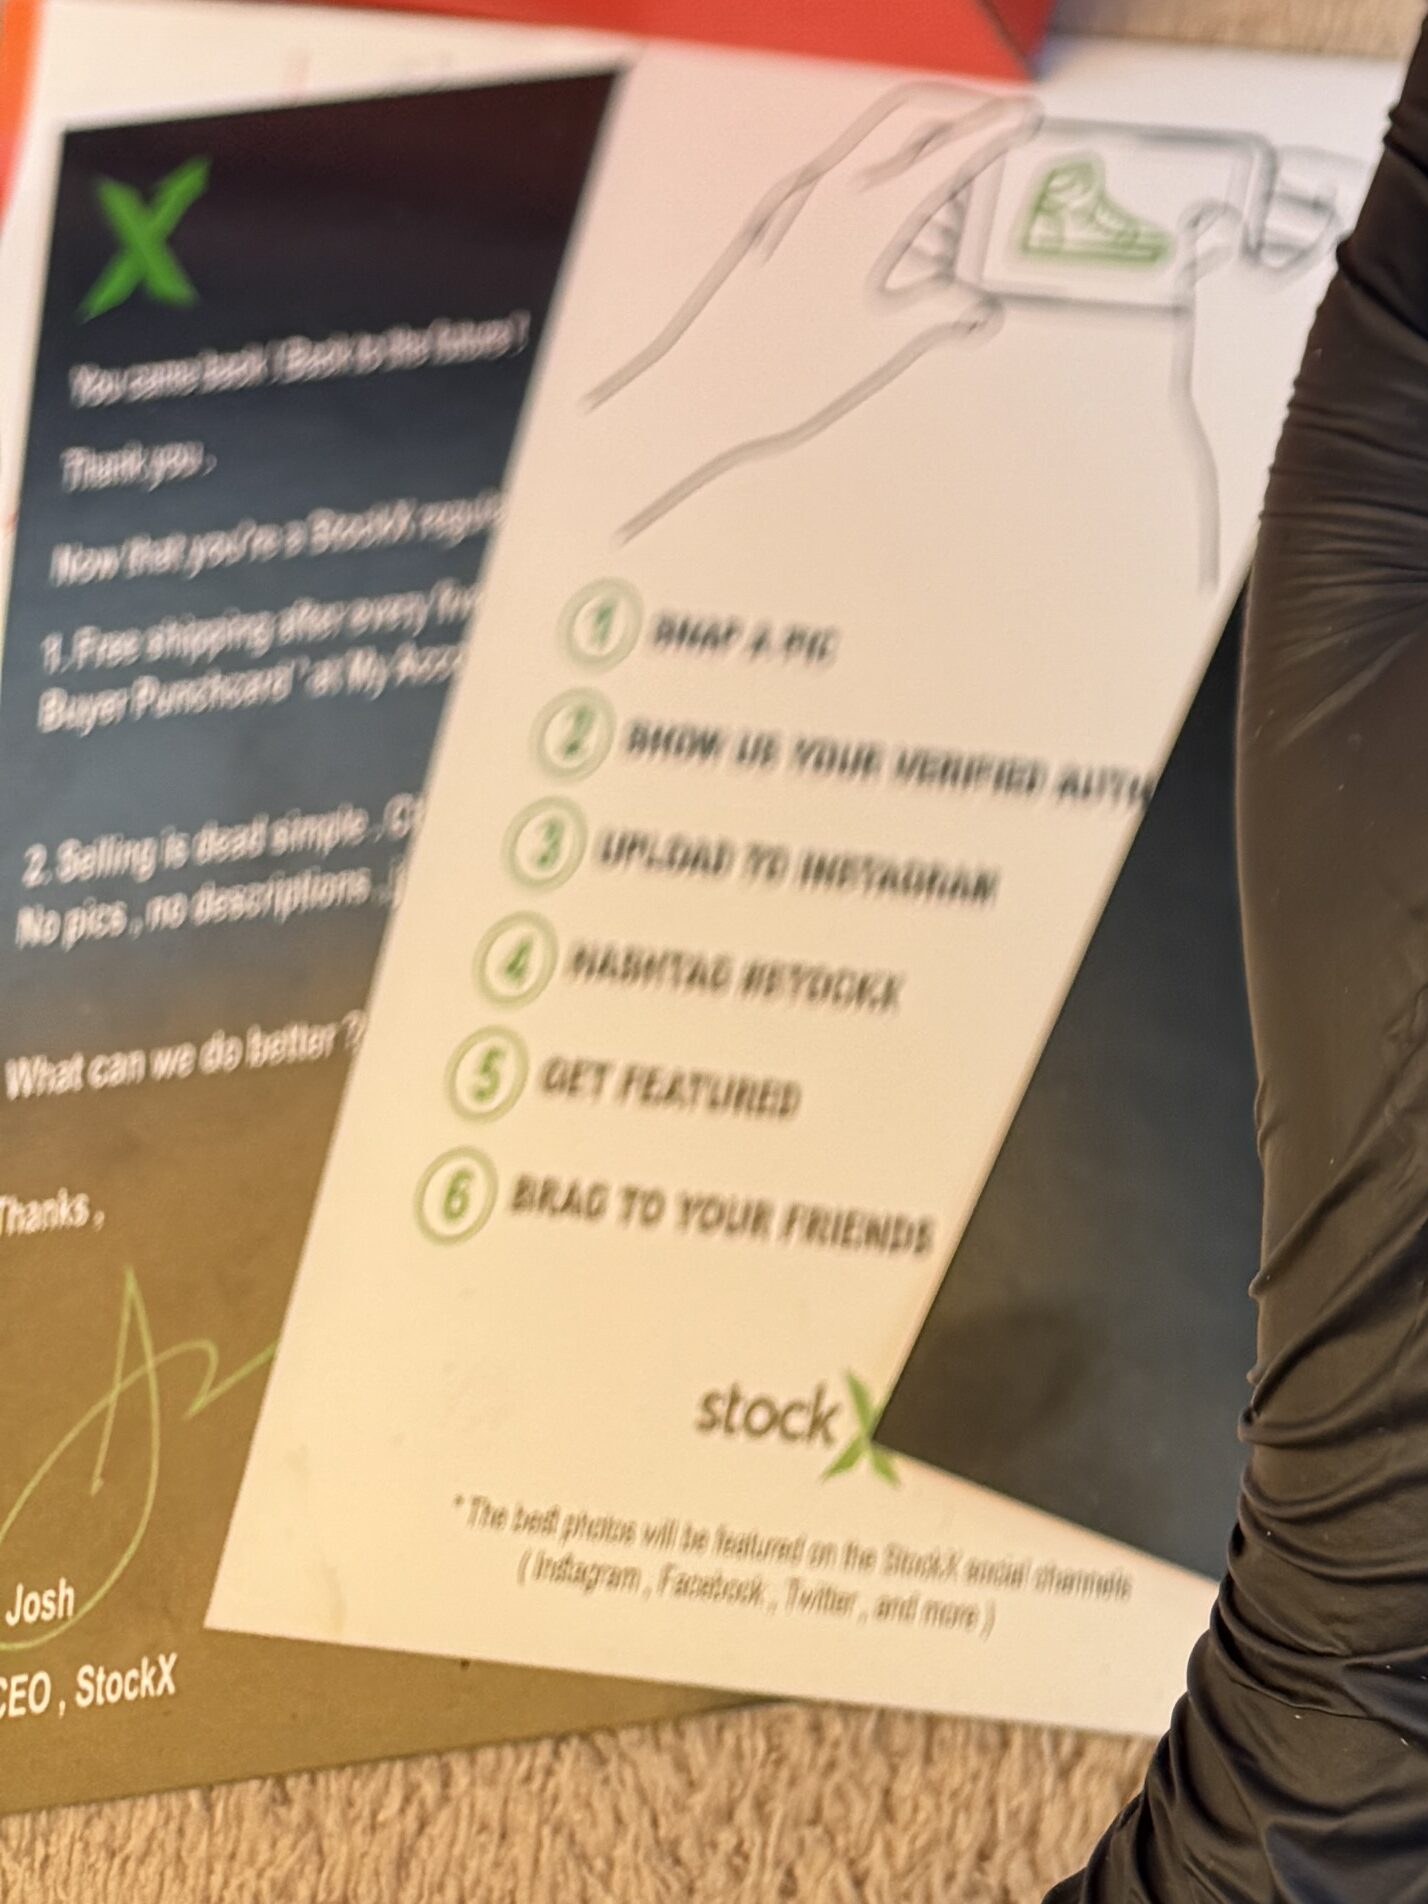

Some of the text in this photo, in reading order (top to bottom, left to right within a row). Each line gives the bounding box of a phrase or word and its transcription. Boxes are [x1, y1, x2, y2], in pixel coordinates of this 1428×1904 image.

[51, 542, 119, 587] Now
[120, 532, 187, 578] that
[72, 624, 142, 670] Free
[143, 607, 274, 665] shipping
[275, 596, 346, 647] after
[346, 589, 428, 638] every
[37, 687, 130, 738] Buyer
[345, 644, 389, 702] My
[796, 733, 881, 781] YOUR
[895, 743, 1051, 803] VERIFIED
[55, 830, 157, 884] Selling
[160, 823, 191, 870] is
[191, 812, 269, 866] dead
[598, 826, 729, 879] UPLOAD
[743, 841, 790, 884] TO
[799, 845, 1001, 907] INSTAGRAM
[15, 902, 61, 949] No
[145, 892, 188, 932] no
[565, 940, 731, 994] HASHTAG
[4, 1051, 84, 1101] What
[86, 1048, 146, 1090] can
[150, 1041, 197, 1082] we
[200, 1028, 243, 1075] do
[539, 1055, 613, 1102] GET
[617, 1065, 803, 1121] FEATURED
[509, 1172, 605, 1224] BRAG
[616, 1186, 665, 1228] TO
[675, 1191, 773, 1242] YOUR
[777, 1198, 936, 1256] FRIENDS
[466, 1493, 508, 1530] The
[511, 1500, 560, 1538] best
[558, 1509, 637, 1548] photos
[641, 1517, 679, 1550] will
[679, 1522, 709, 1553] be
[713, 1522, 806, 1567] featured
[807, 1541, 838, 1570] on
[840, 1540, 877, 1573] the
[881, 1541, 962, 1581] StockX
[1031, 1556, 1132, 1600] channels
[4, 1575, 76, 1628] Josh
[875, 1590, 920, 1623] and
[75, 1651, 179, 1709] StockX
